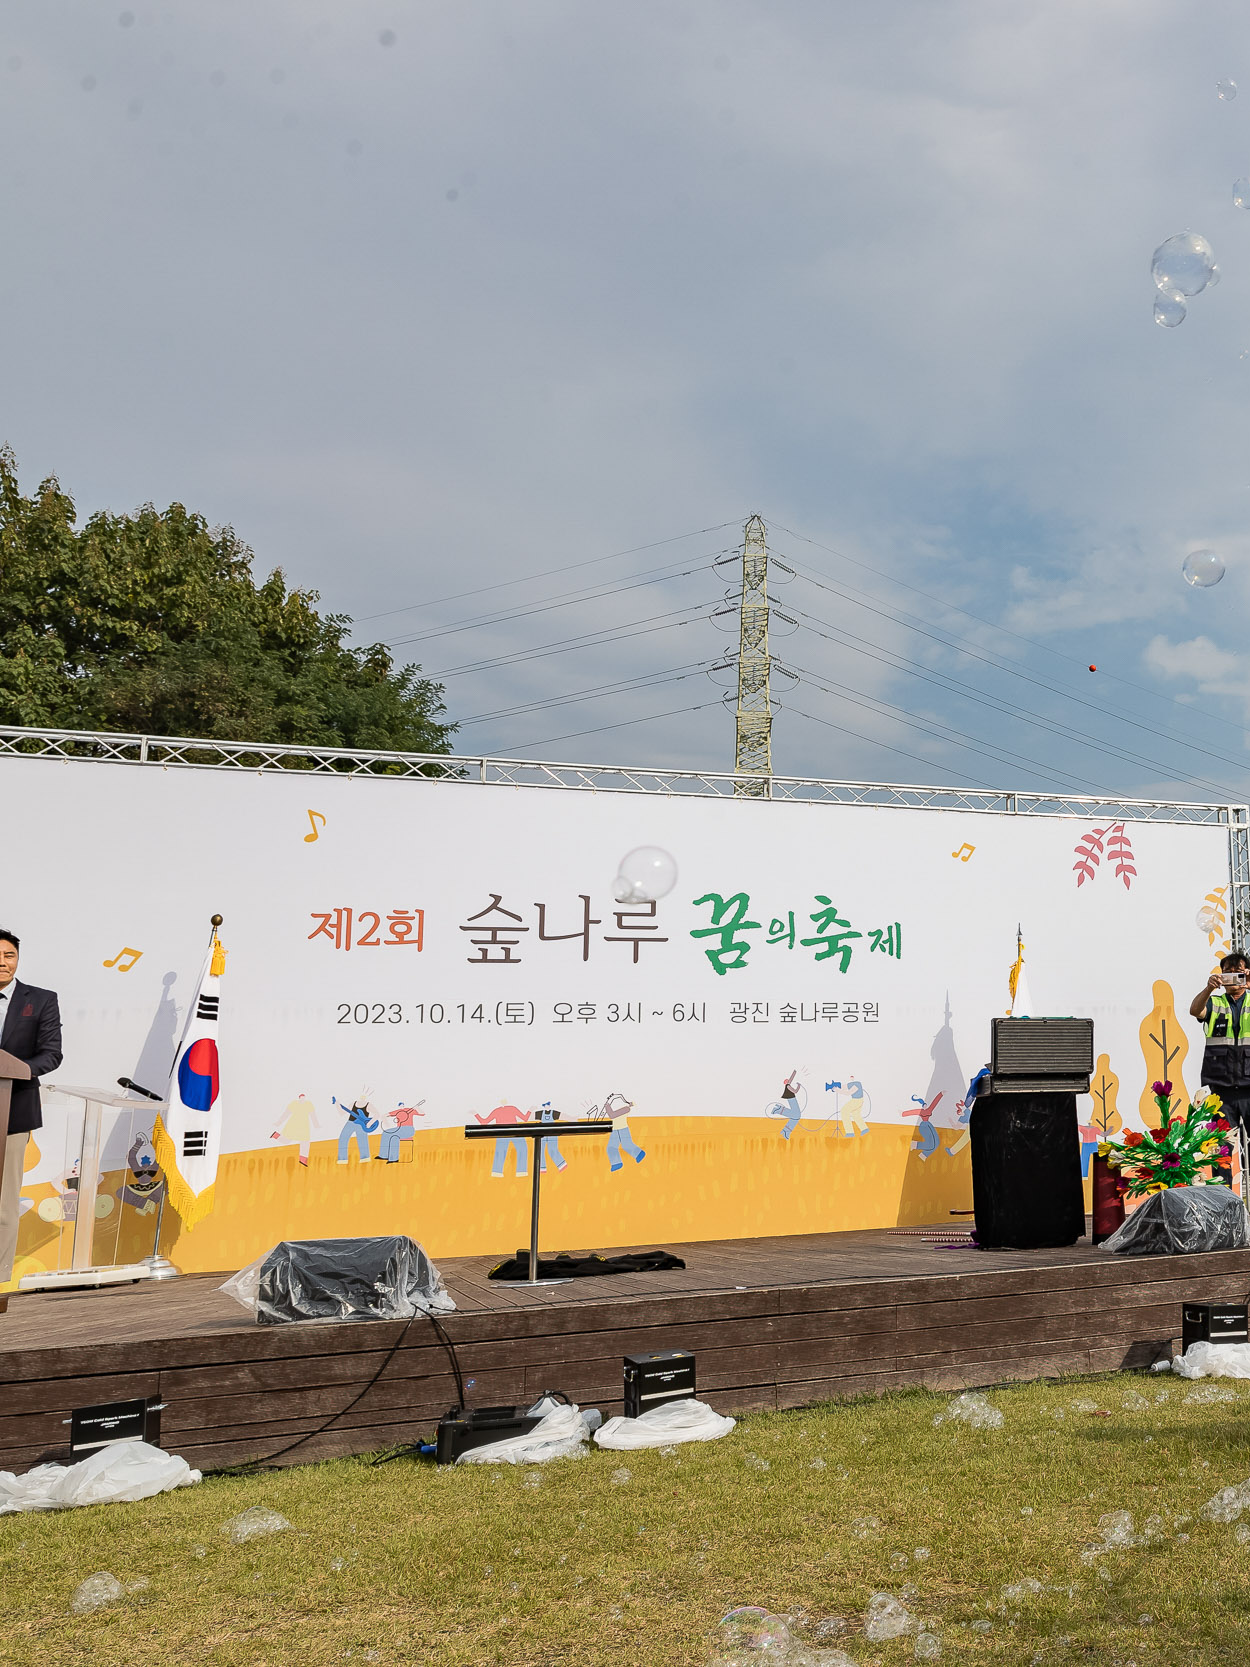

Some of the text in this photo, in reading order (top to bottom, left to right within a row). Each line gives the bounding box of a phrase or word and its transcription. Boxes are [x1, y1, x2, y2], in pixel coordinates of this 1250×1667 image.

[308, 908, 425, 952] 제2회
[459, 893, 669, 963] 숲나루
[337, 1002, 534, 1025] 2023.10.14.(토)
[553, 1002, 596, 1024] 오후
[607, 1003, 641, 1023] 3시
[673, 1003, 705, 1022] 6시
[730, 1003, 768, 1023] 광진
[780, 1003, 878, 1022] 숲나루공원
